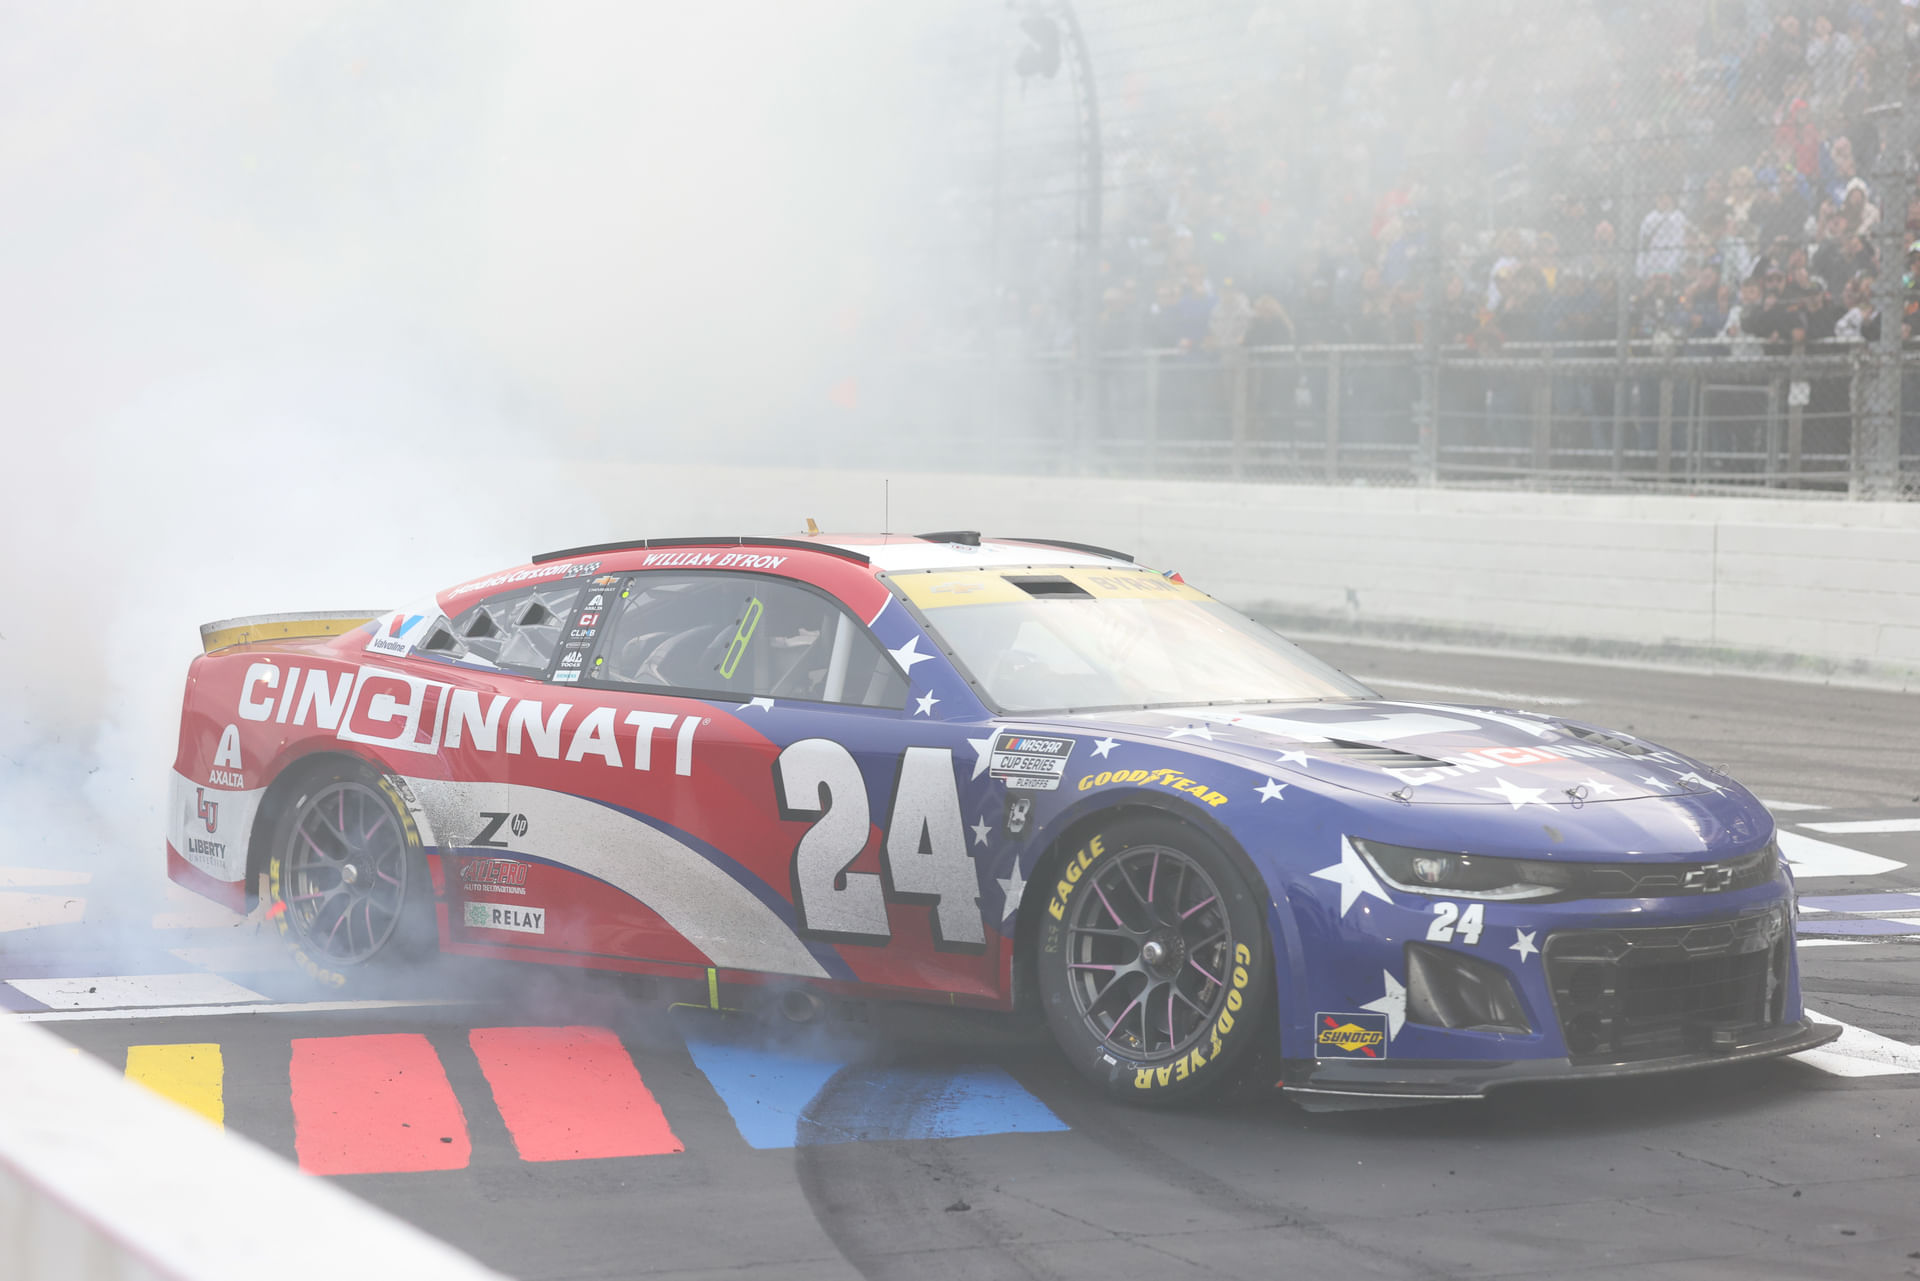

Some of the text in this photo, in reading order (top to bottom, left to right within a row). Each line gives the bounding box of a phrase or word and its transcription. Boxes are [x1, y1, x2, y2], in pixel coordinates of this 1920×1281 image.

[642, 553, 788, 569] WILLIAM BYRON
[374, 639, 406, 652] Valvoline
[238, 663, 702, 777] CINCINNATI
[1018, 738, 1062, 753] NASCAR
[1000, 756, 1056, 771] CUP SERIES
[209, 769, 244, 788] AXALTA
[1016, 778, 1049, 788] PLAYOFFS
[1078, 769, 1228, 807] GOODYEAR
[469, 812, 528, 847] Z hp
[188, 838, 226, 859] LIBERTY
[775, 738, 987, 947] 24
[1049, 834, 1105, 920] EAGLE
[492, 908, 541, 928] RELAY
[1426, 902, 1484, 944] 24
[1134, 943, 1250, 1088] GOODYEAR
[1321, 1031, 1381, 1044] SUNOCO
